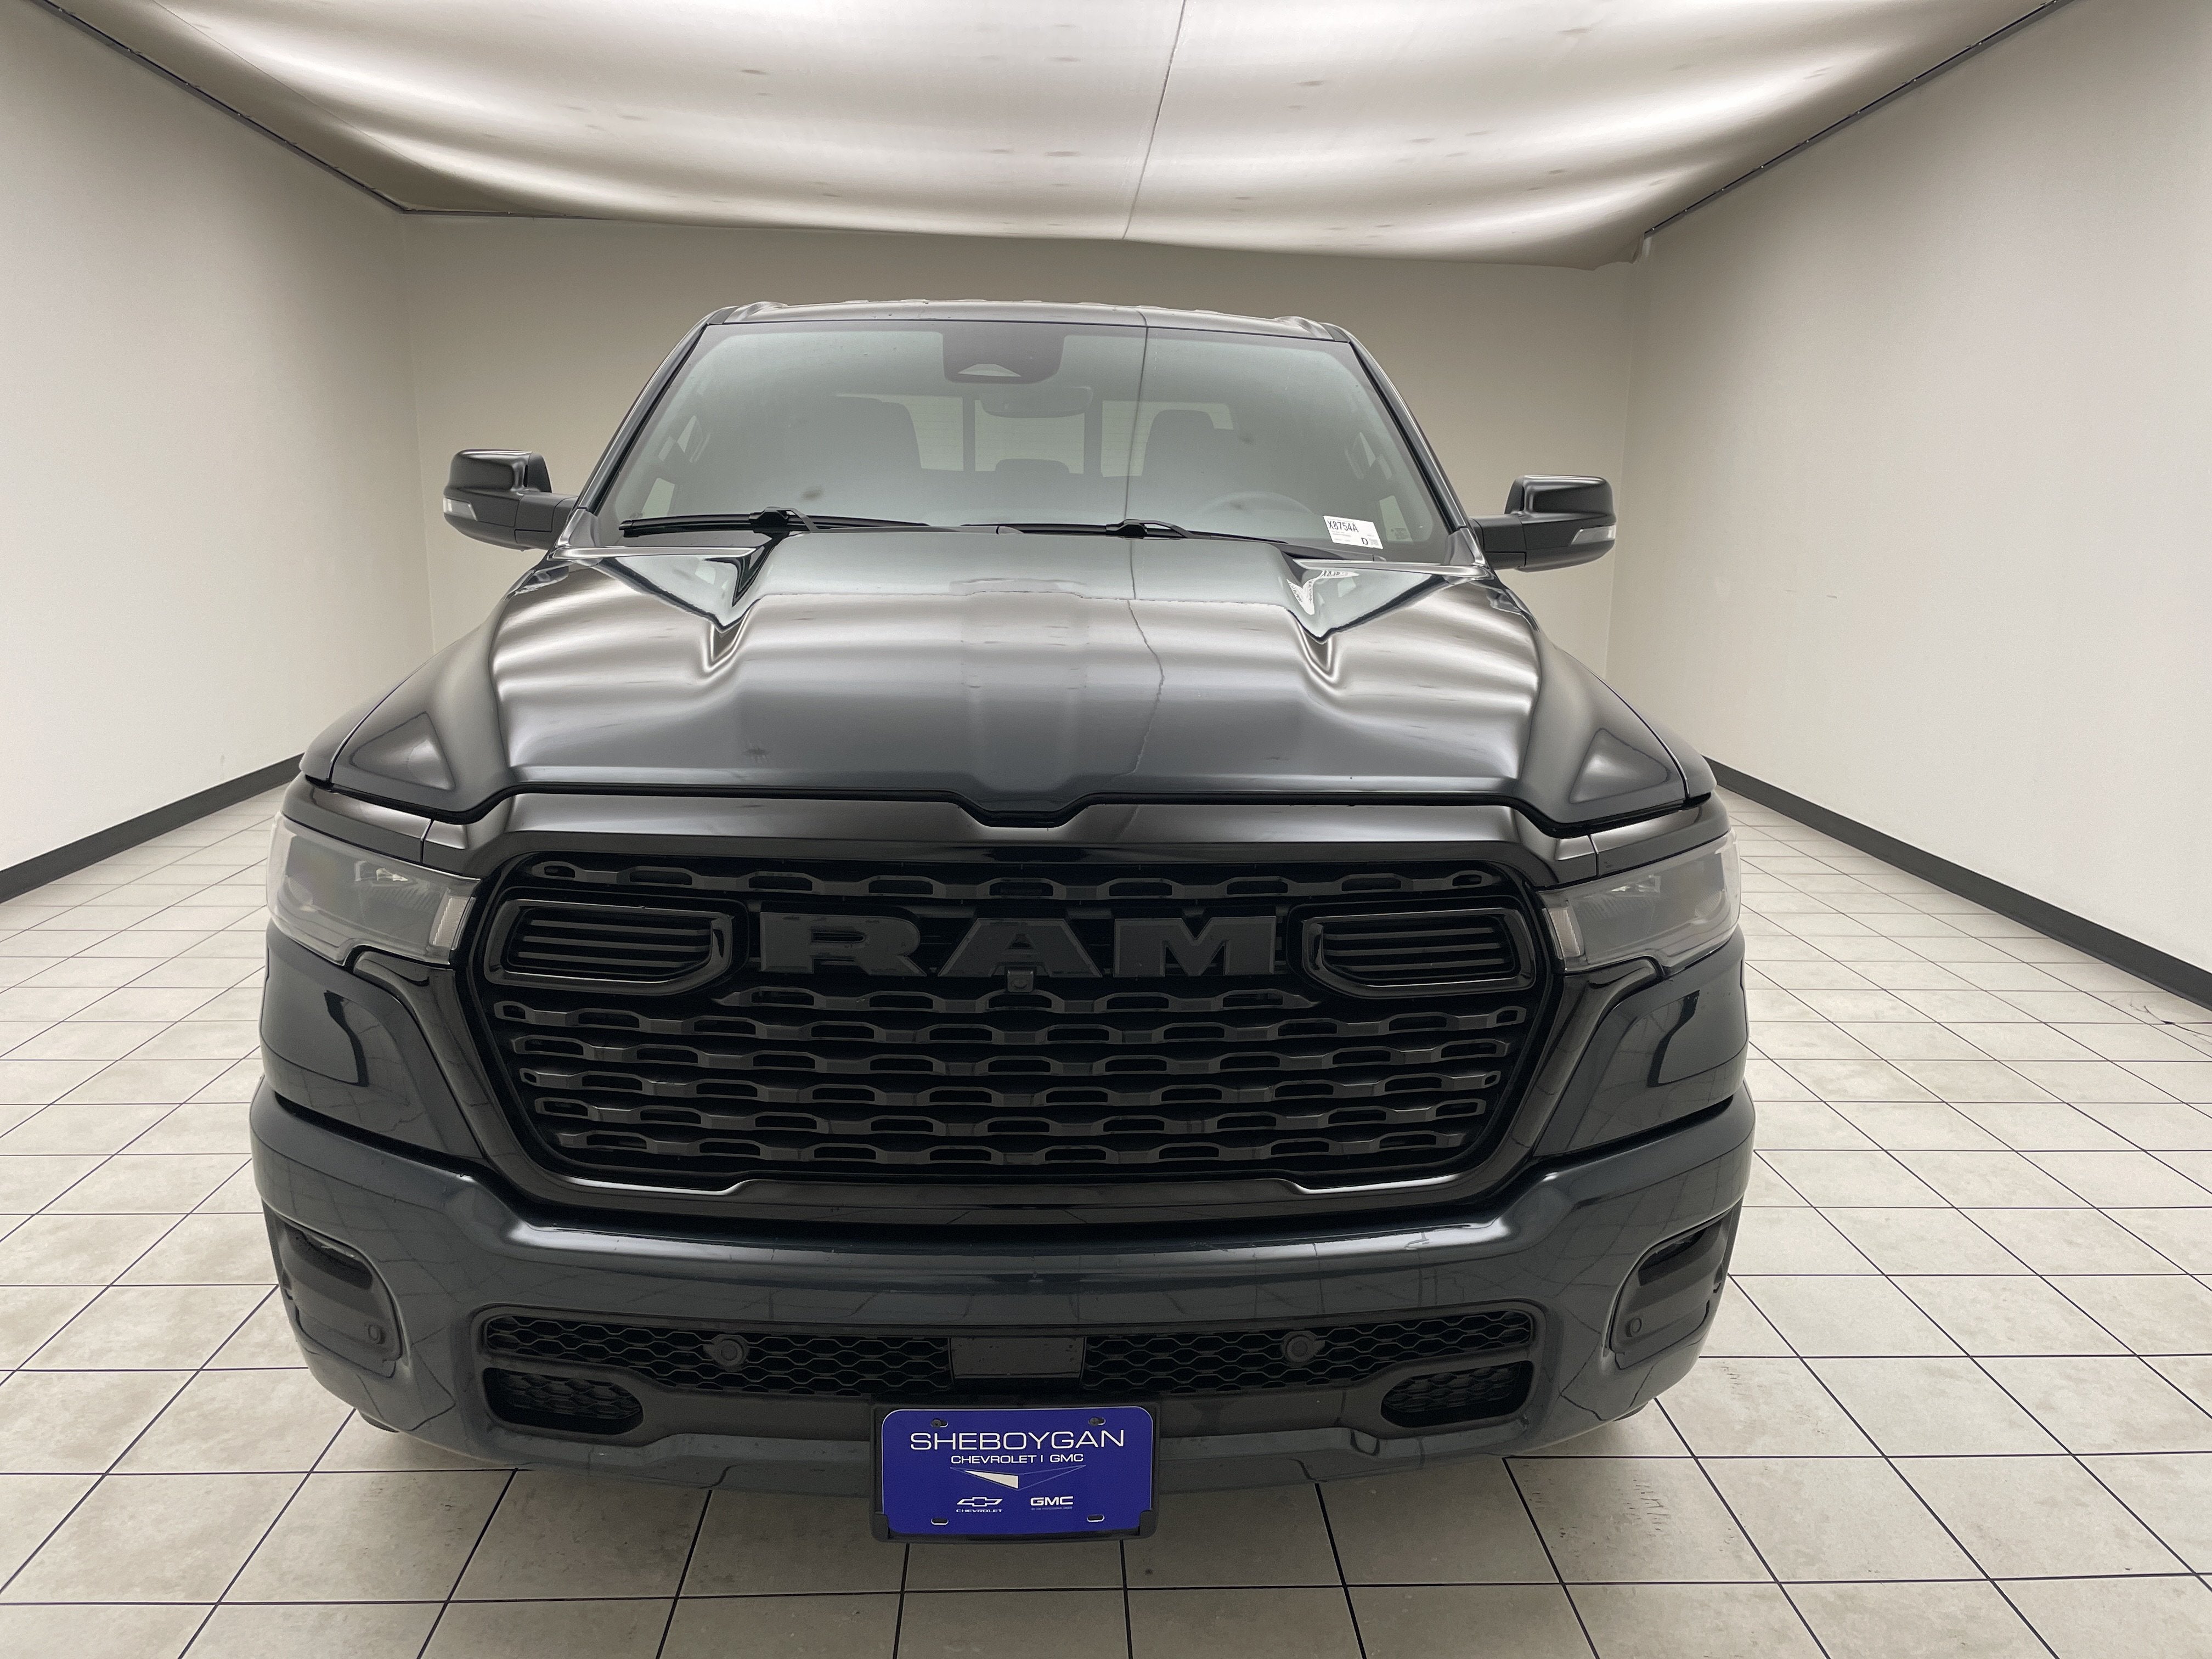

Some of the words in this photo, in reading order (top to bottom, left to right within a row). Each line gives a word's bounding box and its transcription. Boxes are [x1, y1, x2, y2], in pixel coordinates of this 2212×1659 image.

[760, 912, 1277, 977] RAM
[910, 1429, 1125, 1451] SHEBOYGAN
[951, 1455, 1037, 1464] CHEVROLET
[1049, 1453, 1084, 1463] GMC
[1030, 1496, 1074, 1506] GMC
